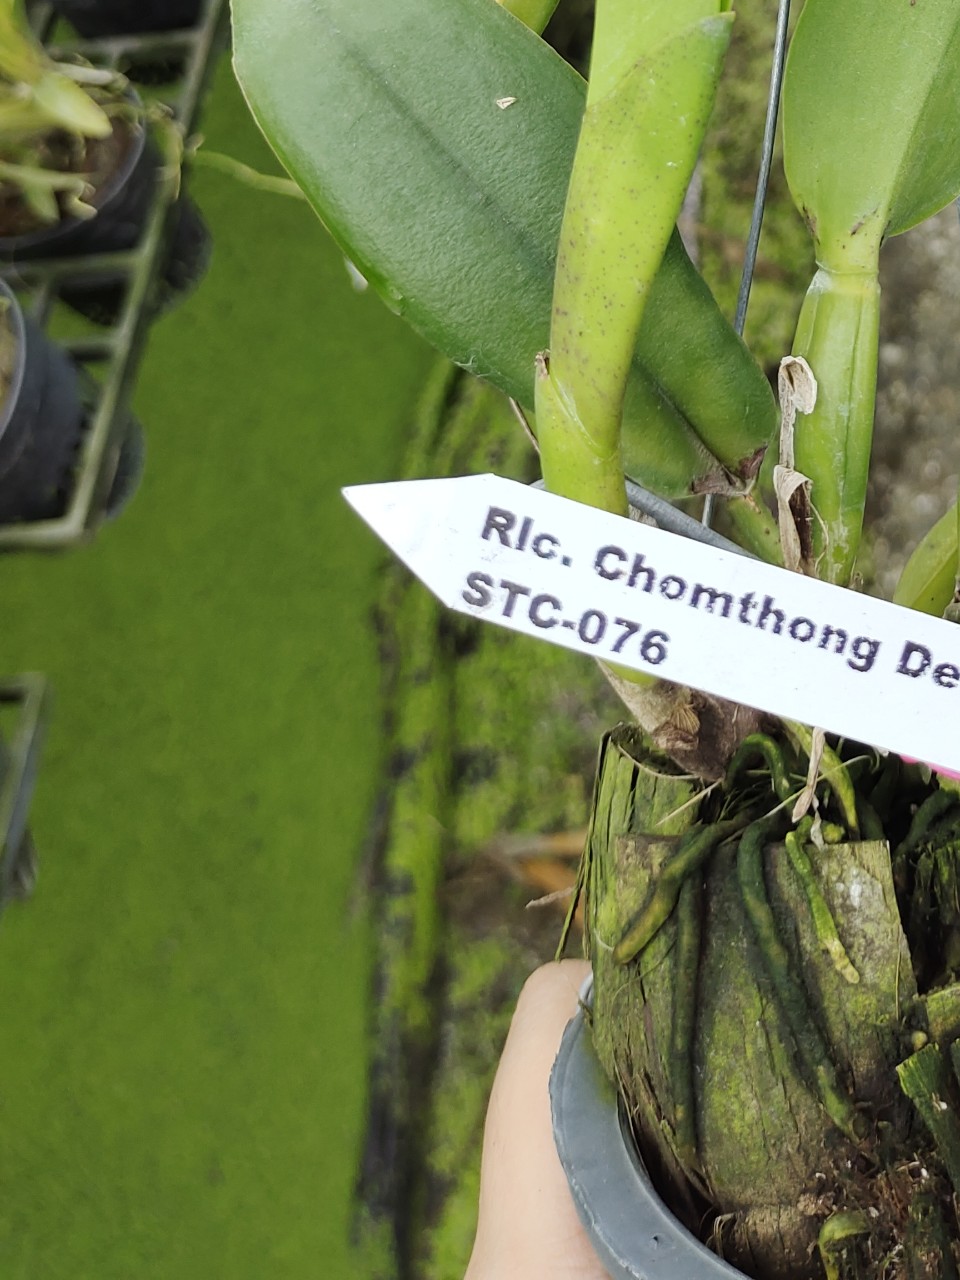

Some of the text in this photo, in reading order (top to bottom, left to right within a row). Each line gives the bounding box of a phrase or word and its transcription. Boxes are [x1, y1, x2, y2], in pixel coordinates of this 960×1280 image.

[462, 572, 669, 666] STC-076
[481, 506, 572, 567] Rlc.
[594, 546, 881, 673] Chomthong
